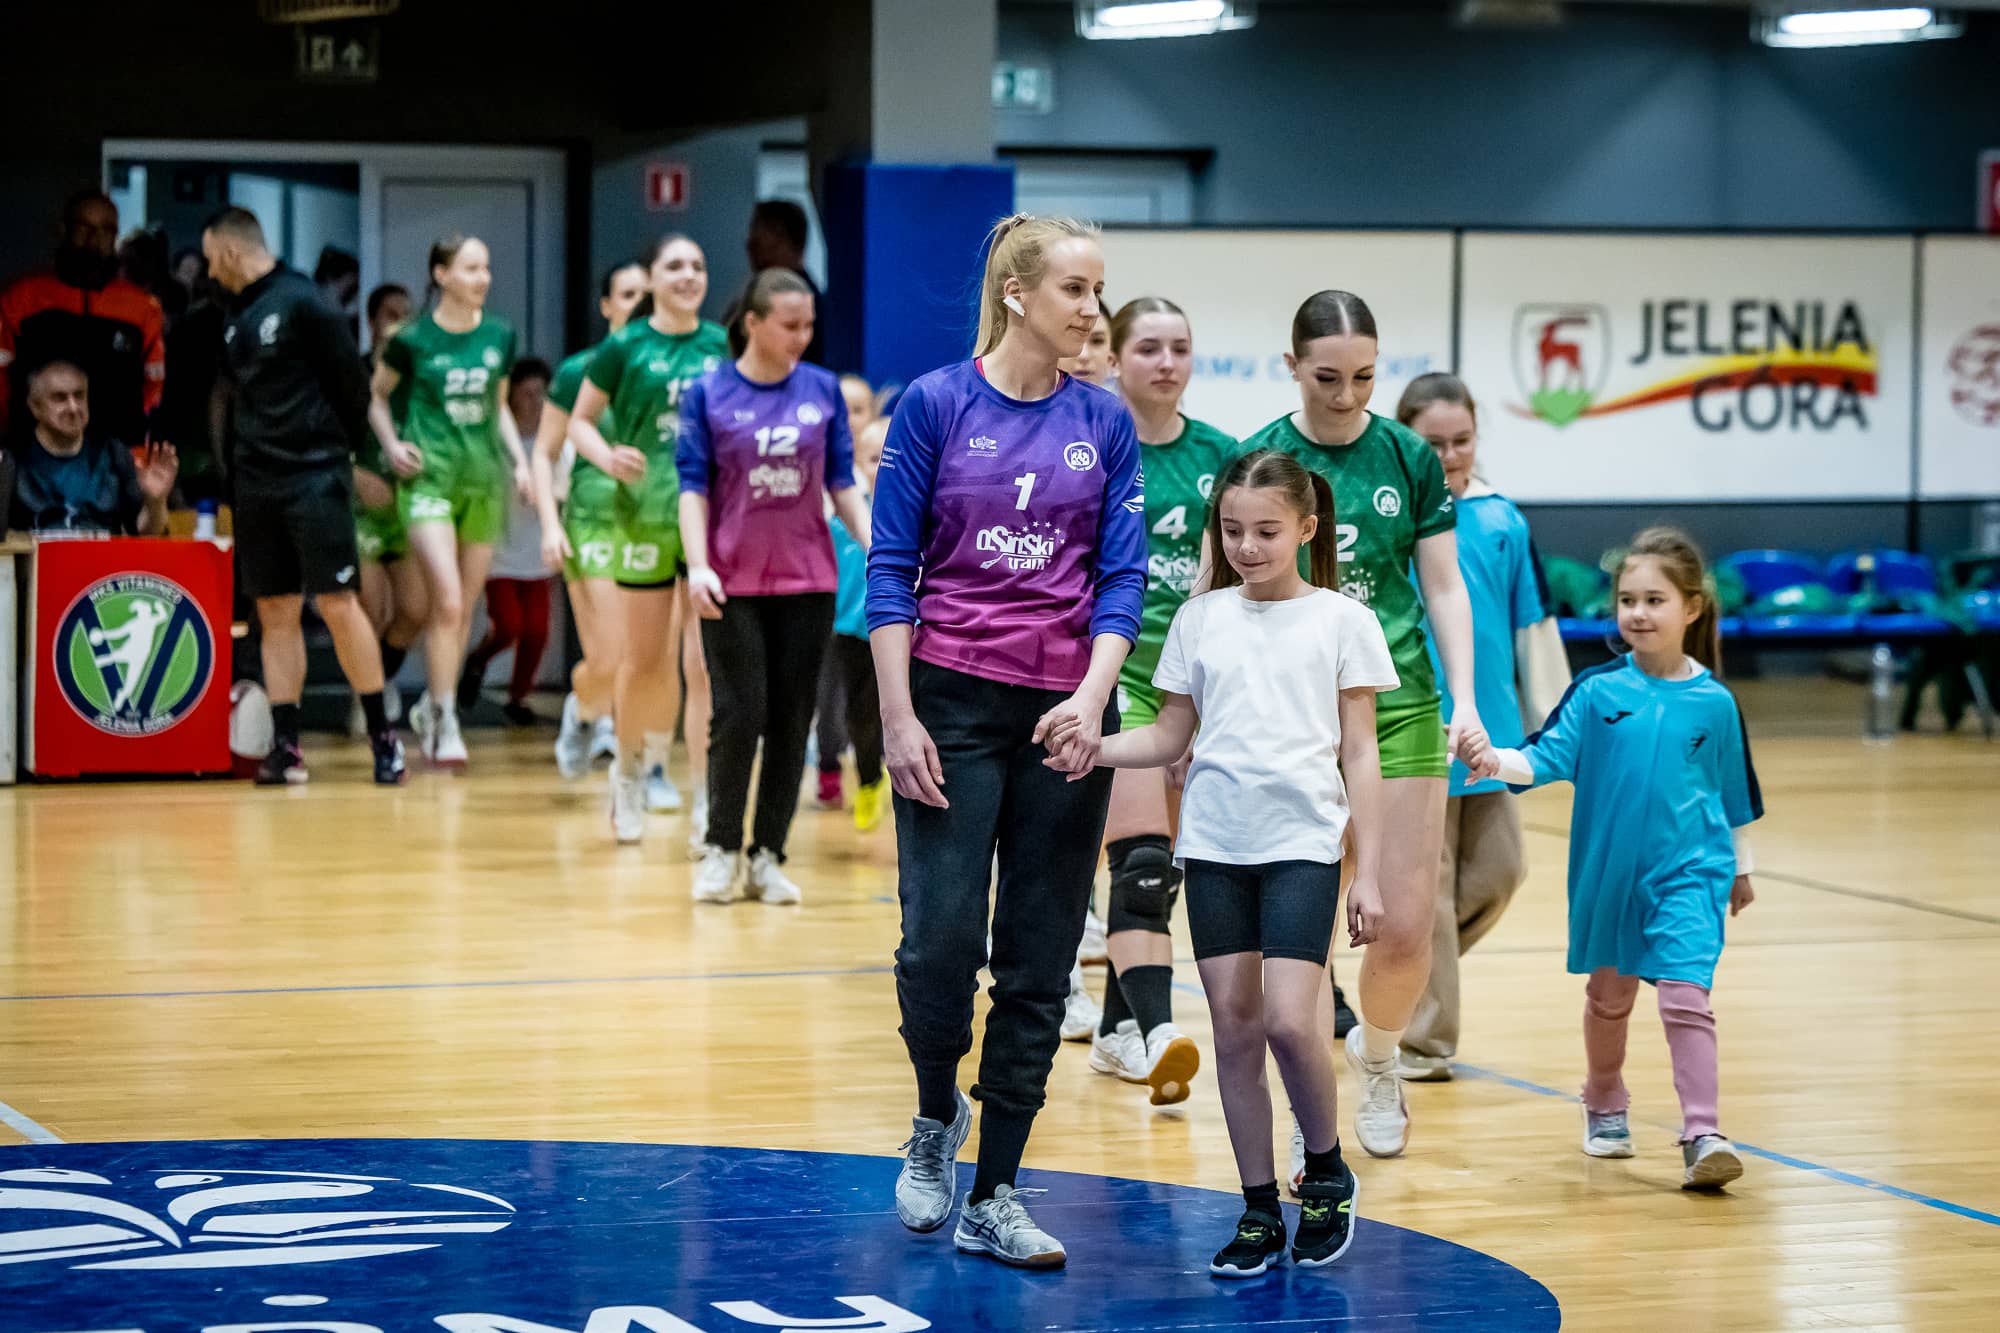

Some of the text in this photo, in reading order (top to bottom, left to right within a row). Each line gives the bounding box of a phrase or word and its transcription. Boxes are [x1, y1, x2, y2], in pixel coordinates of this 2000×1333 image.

[1631, 299, 1871, 364] JELENIA
[444, 368, 489, 395] 22
[1692, 364, 1869, 432] GÓRA
[754, 426, 799, 457] 12
[1014, 473, 1036, 510] 1
[1151, 505, 1188, 540] 4
[622, 543, 659, 571] 13
